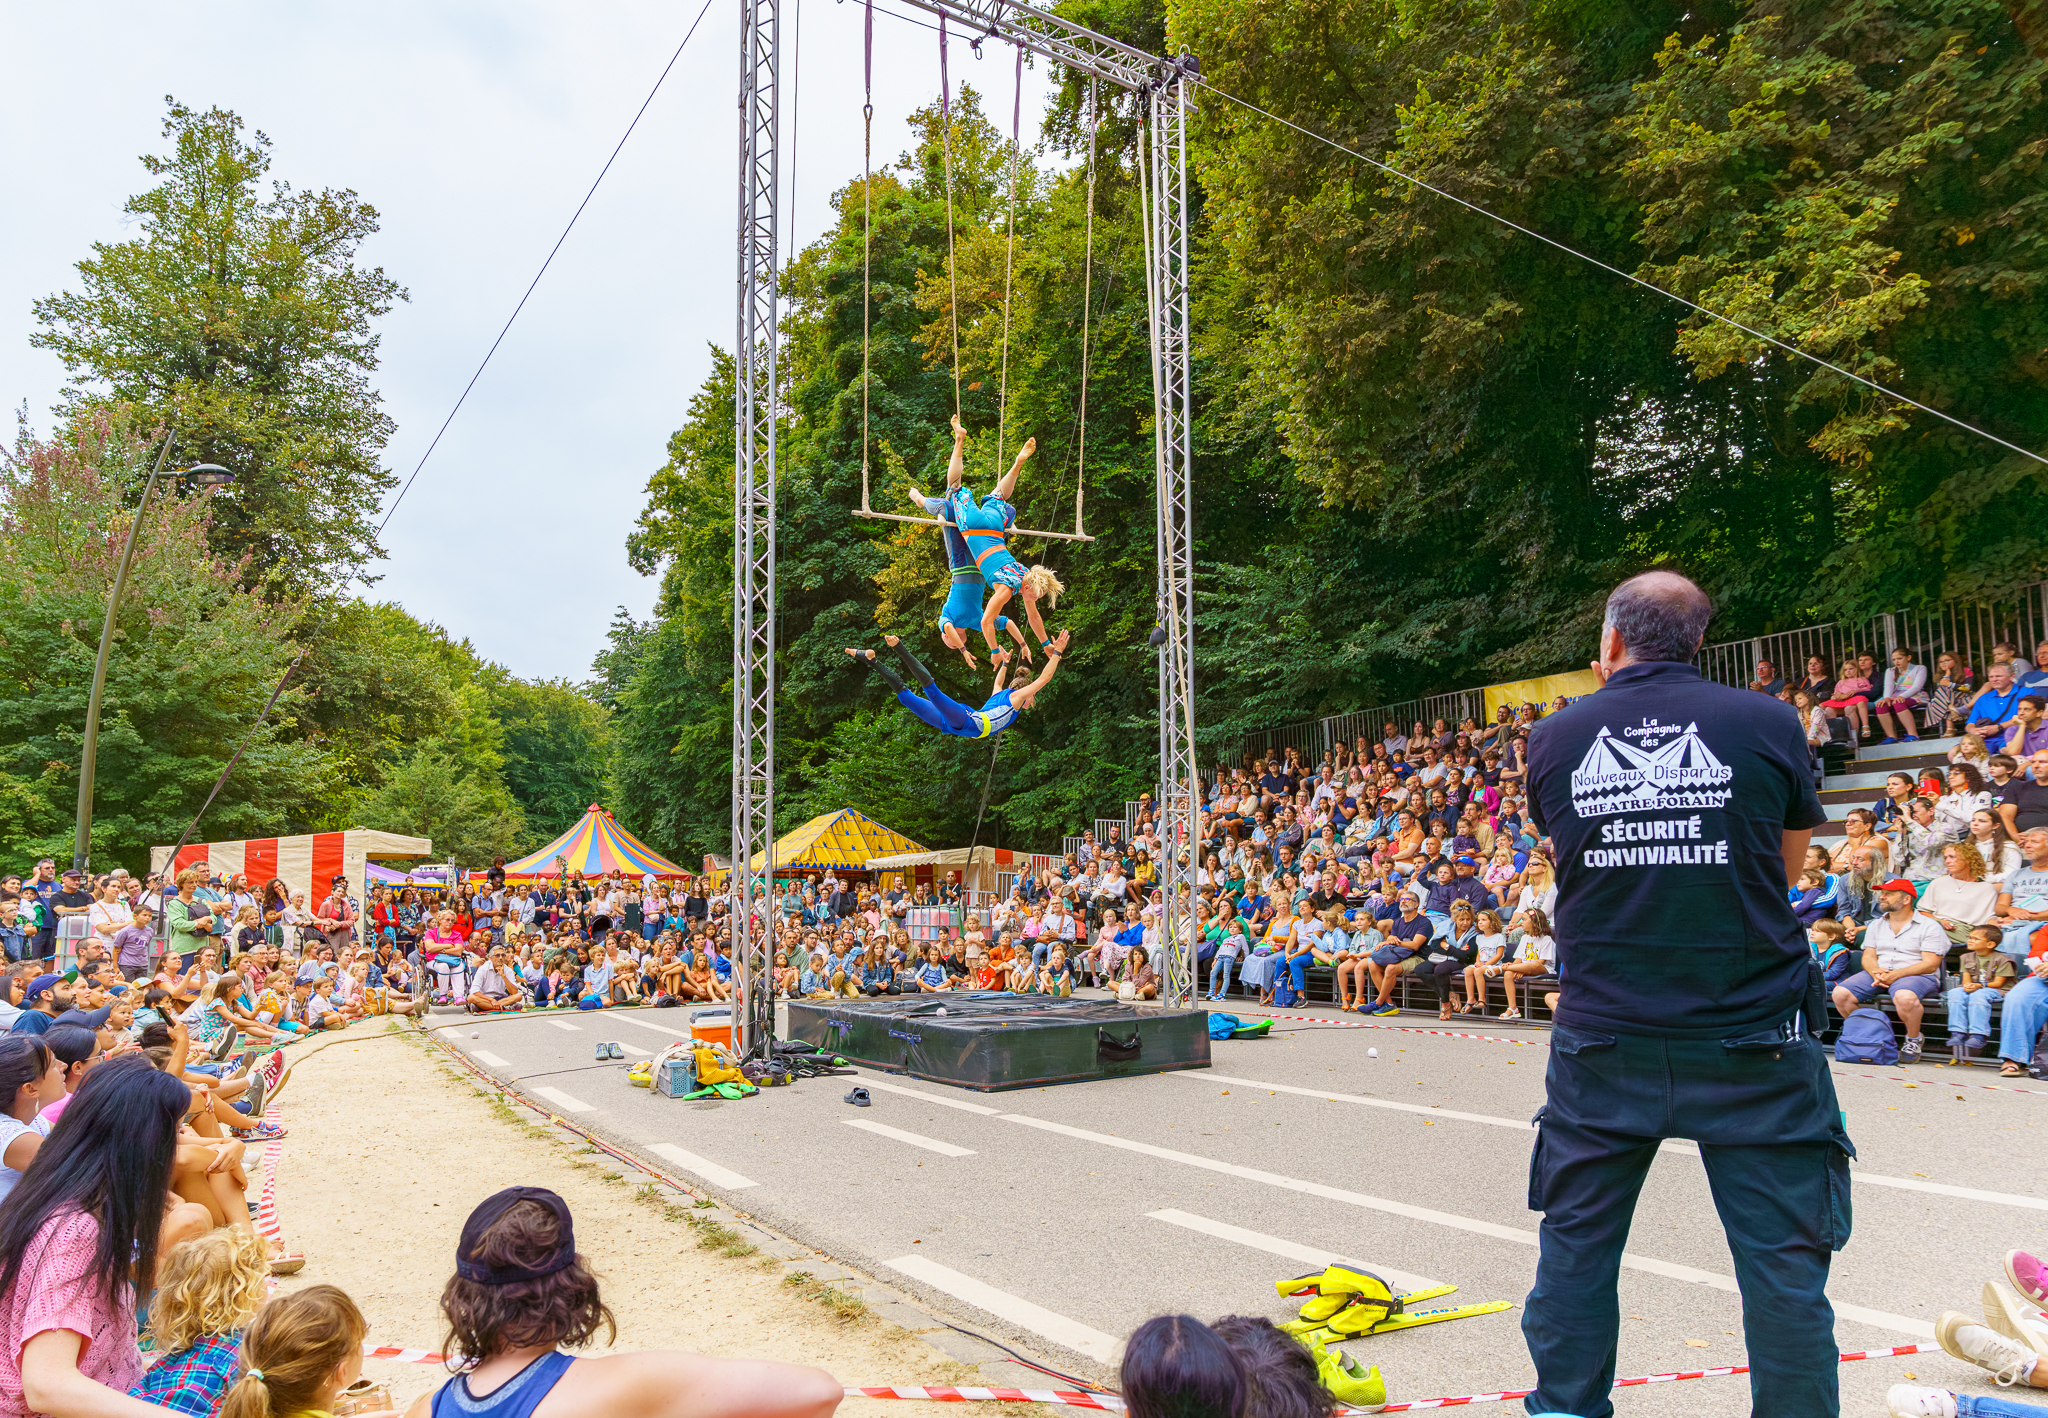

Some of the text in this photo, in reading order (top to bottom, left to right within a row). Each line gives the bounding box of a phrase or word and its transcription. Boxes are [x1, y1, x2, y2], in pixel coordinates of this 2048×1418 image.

[1624, 724, 1682, 737] Compagnie
[1643, 717, 1658, 727] La
[1640, 737, 1659, 747] des
[1573, 765, 1730, 789] Nouveaux Disparus
[1579, 795, 1724, 817] THEATRE FORAIN
[1601, 815, 1702, 843] SÉCURITÉ
[1583, 840, 1729, 868] CONVIVIALITÉ
